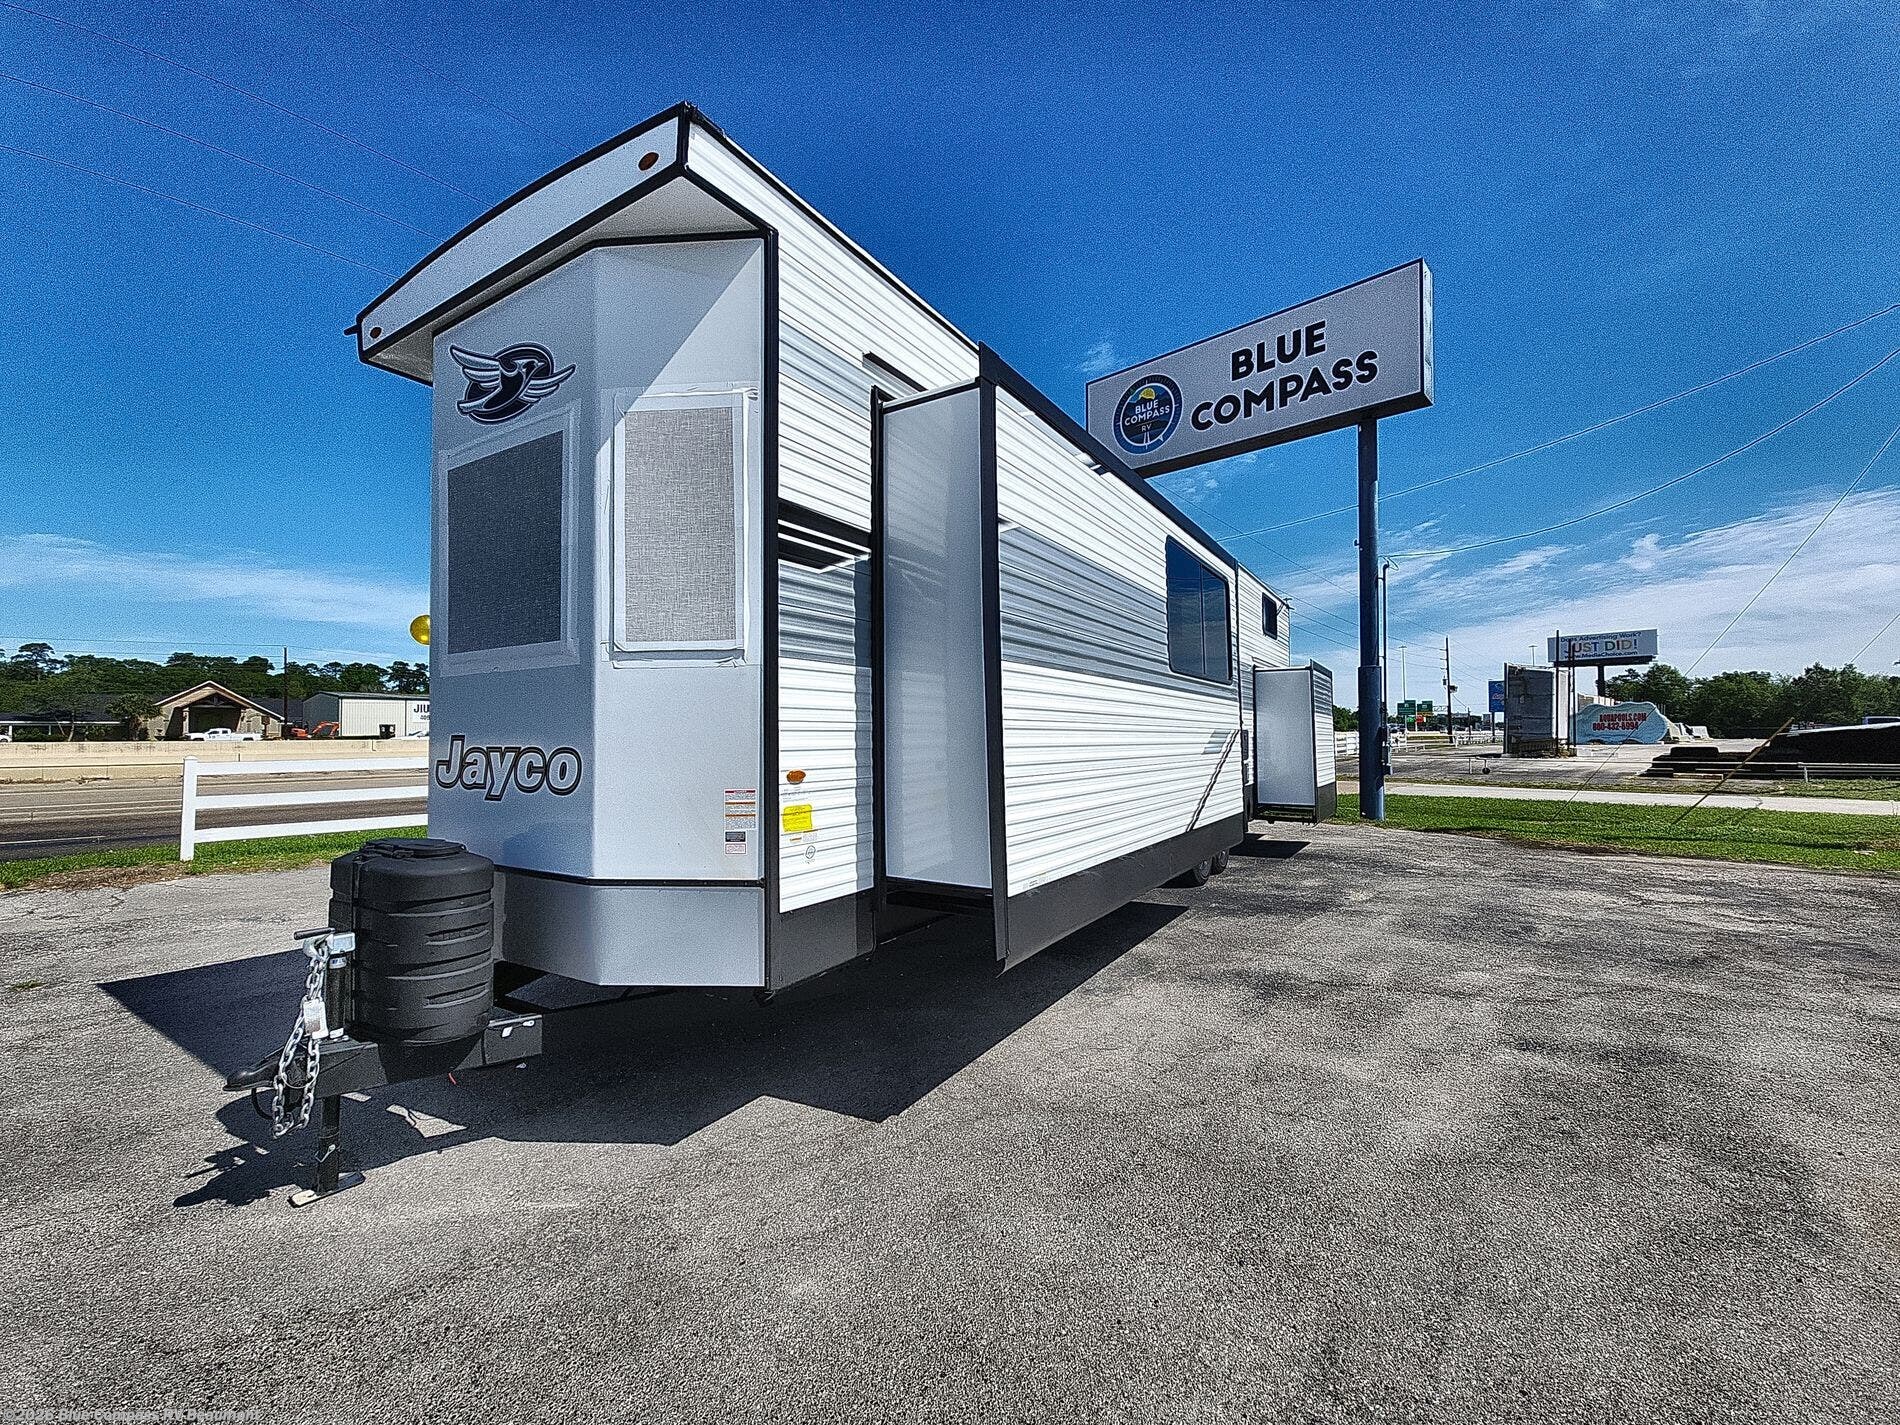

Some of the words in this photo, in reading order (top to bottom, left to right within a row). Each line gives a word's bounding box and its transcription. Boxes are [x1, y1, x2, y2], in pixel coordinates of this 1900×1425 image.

[1231, 320, 1327, 381] BLUE
[1190, 350, 1379, 431] COMPASS
[1124, 405, 1170, 426] COMPASS
[1135, 399, 1159, 415] BLUE
[1141, 423, 1152, 432] RV
[1579, 633, 1618, 641] Advertising
[1620, 631, 1642, 639] Work?
[1604, 639, 1638, 652] DID!
[435, 734, 583, 801] Jayco
